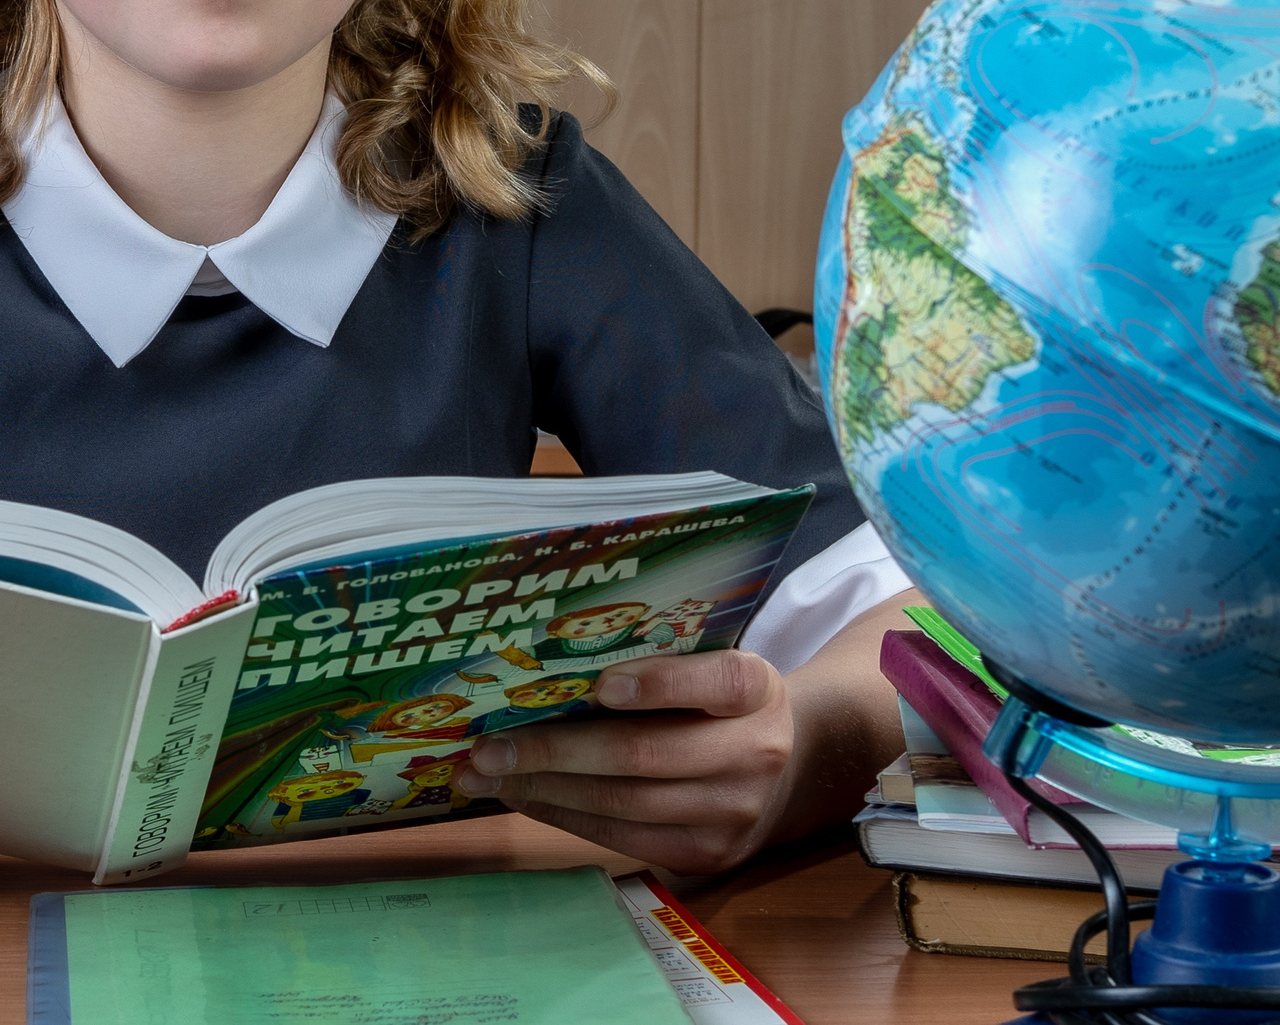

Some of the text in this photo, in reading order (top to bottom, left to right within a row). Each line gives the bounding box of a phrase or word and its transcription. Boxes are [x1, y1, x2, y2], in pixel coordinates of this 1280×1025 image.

[251, 556, 640, 640] ГОВОРИМ
[260, 513, 746, 602] М. В. ГОЛОВАНОВА, Н. Б. КАРАШЕВА
[235, 627, 534, 690] ПИШЕМ
[245, 597, 558, 662] ЧИТАЕМ
[132, 656, 217, 858] ГОВОРИМ ЧИТАЕМ ПИШЕМ
[648, 904, 699, 942] ТАБЛИЦА
[681, 937, 747, 986] УМНОЖЕНИЯ
